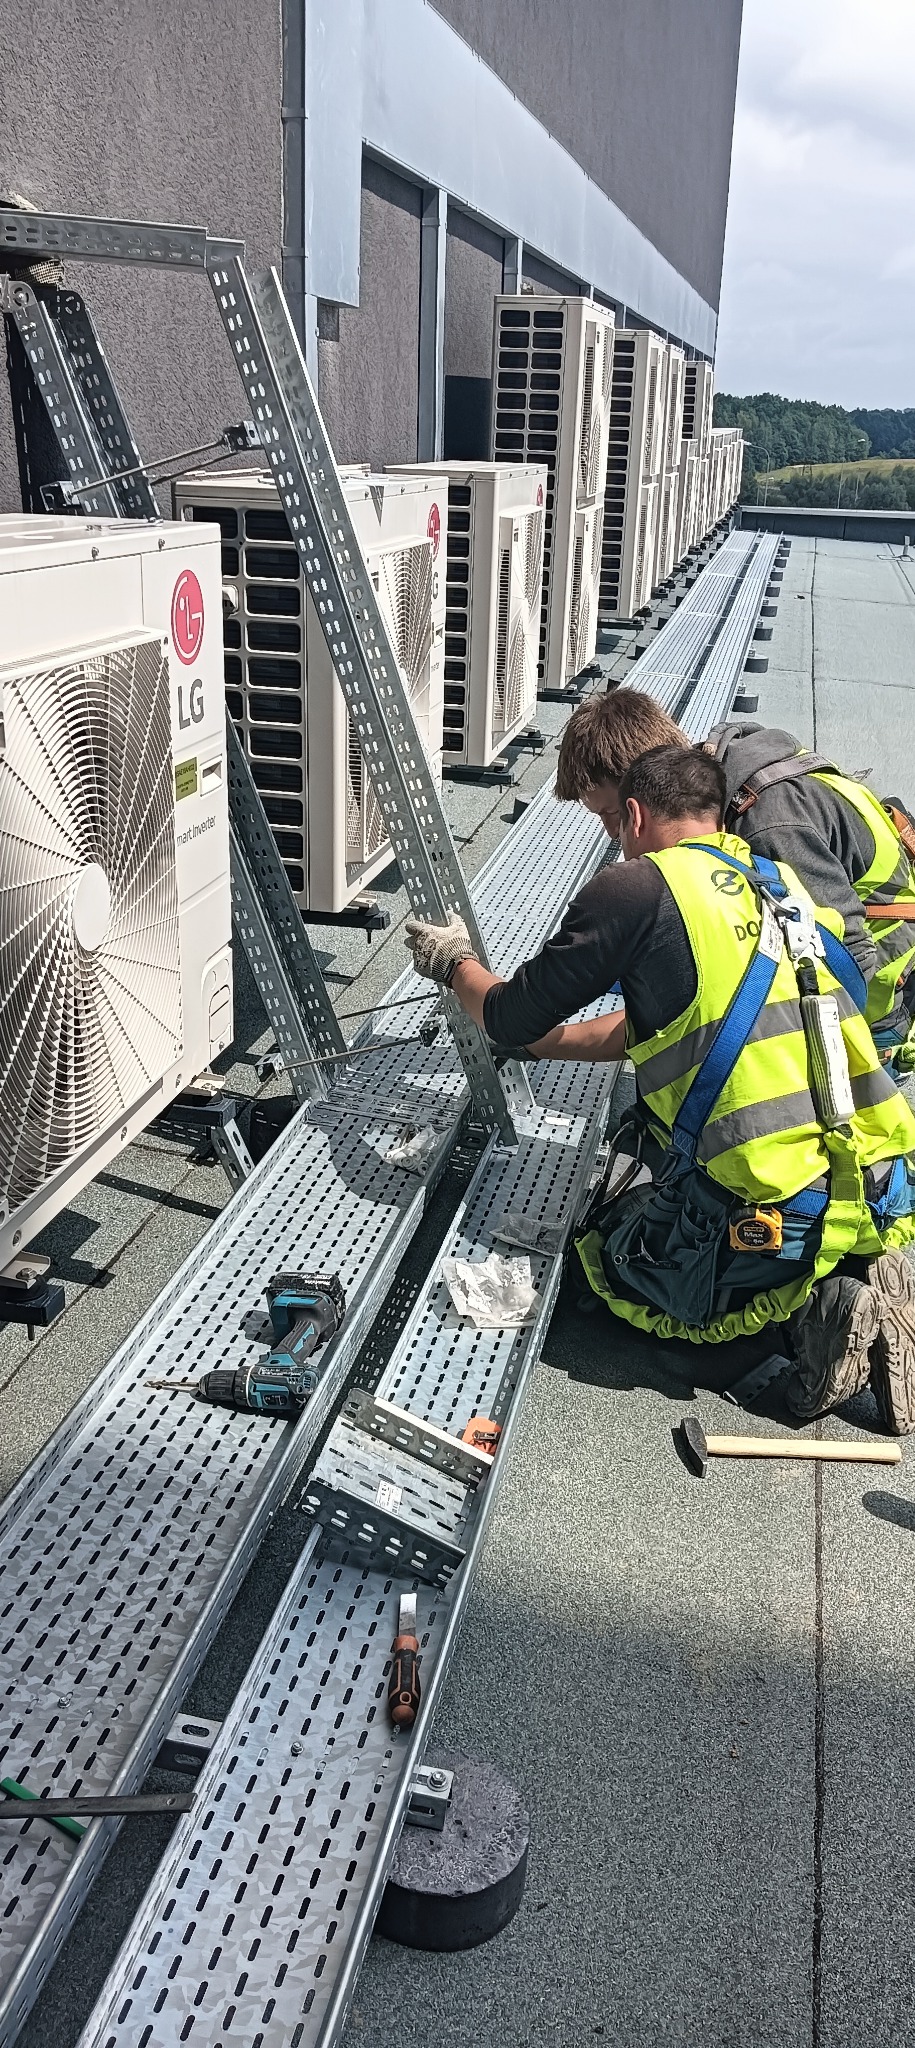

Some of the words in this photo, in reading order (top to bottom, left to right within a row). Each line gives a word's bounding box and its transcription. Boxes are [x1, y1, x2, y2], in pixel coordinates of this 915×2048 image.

[178, 679, 205, 730] LG
[176, 827, 192, 847] mart
[192, 815, 217, 838] Inverter
[734, 918, 763, 942] DO
